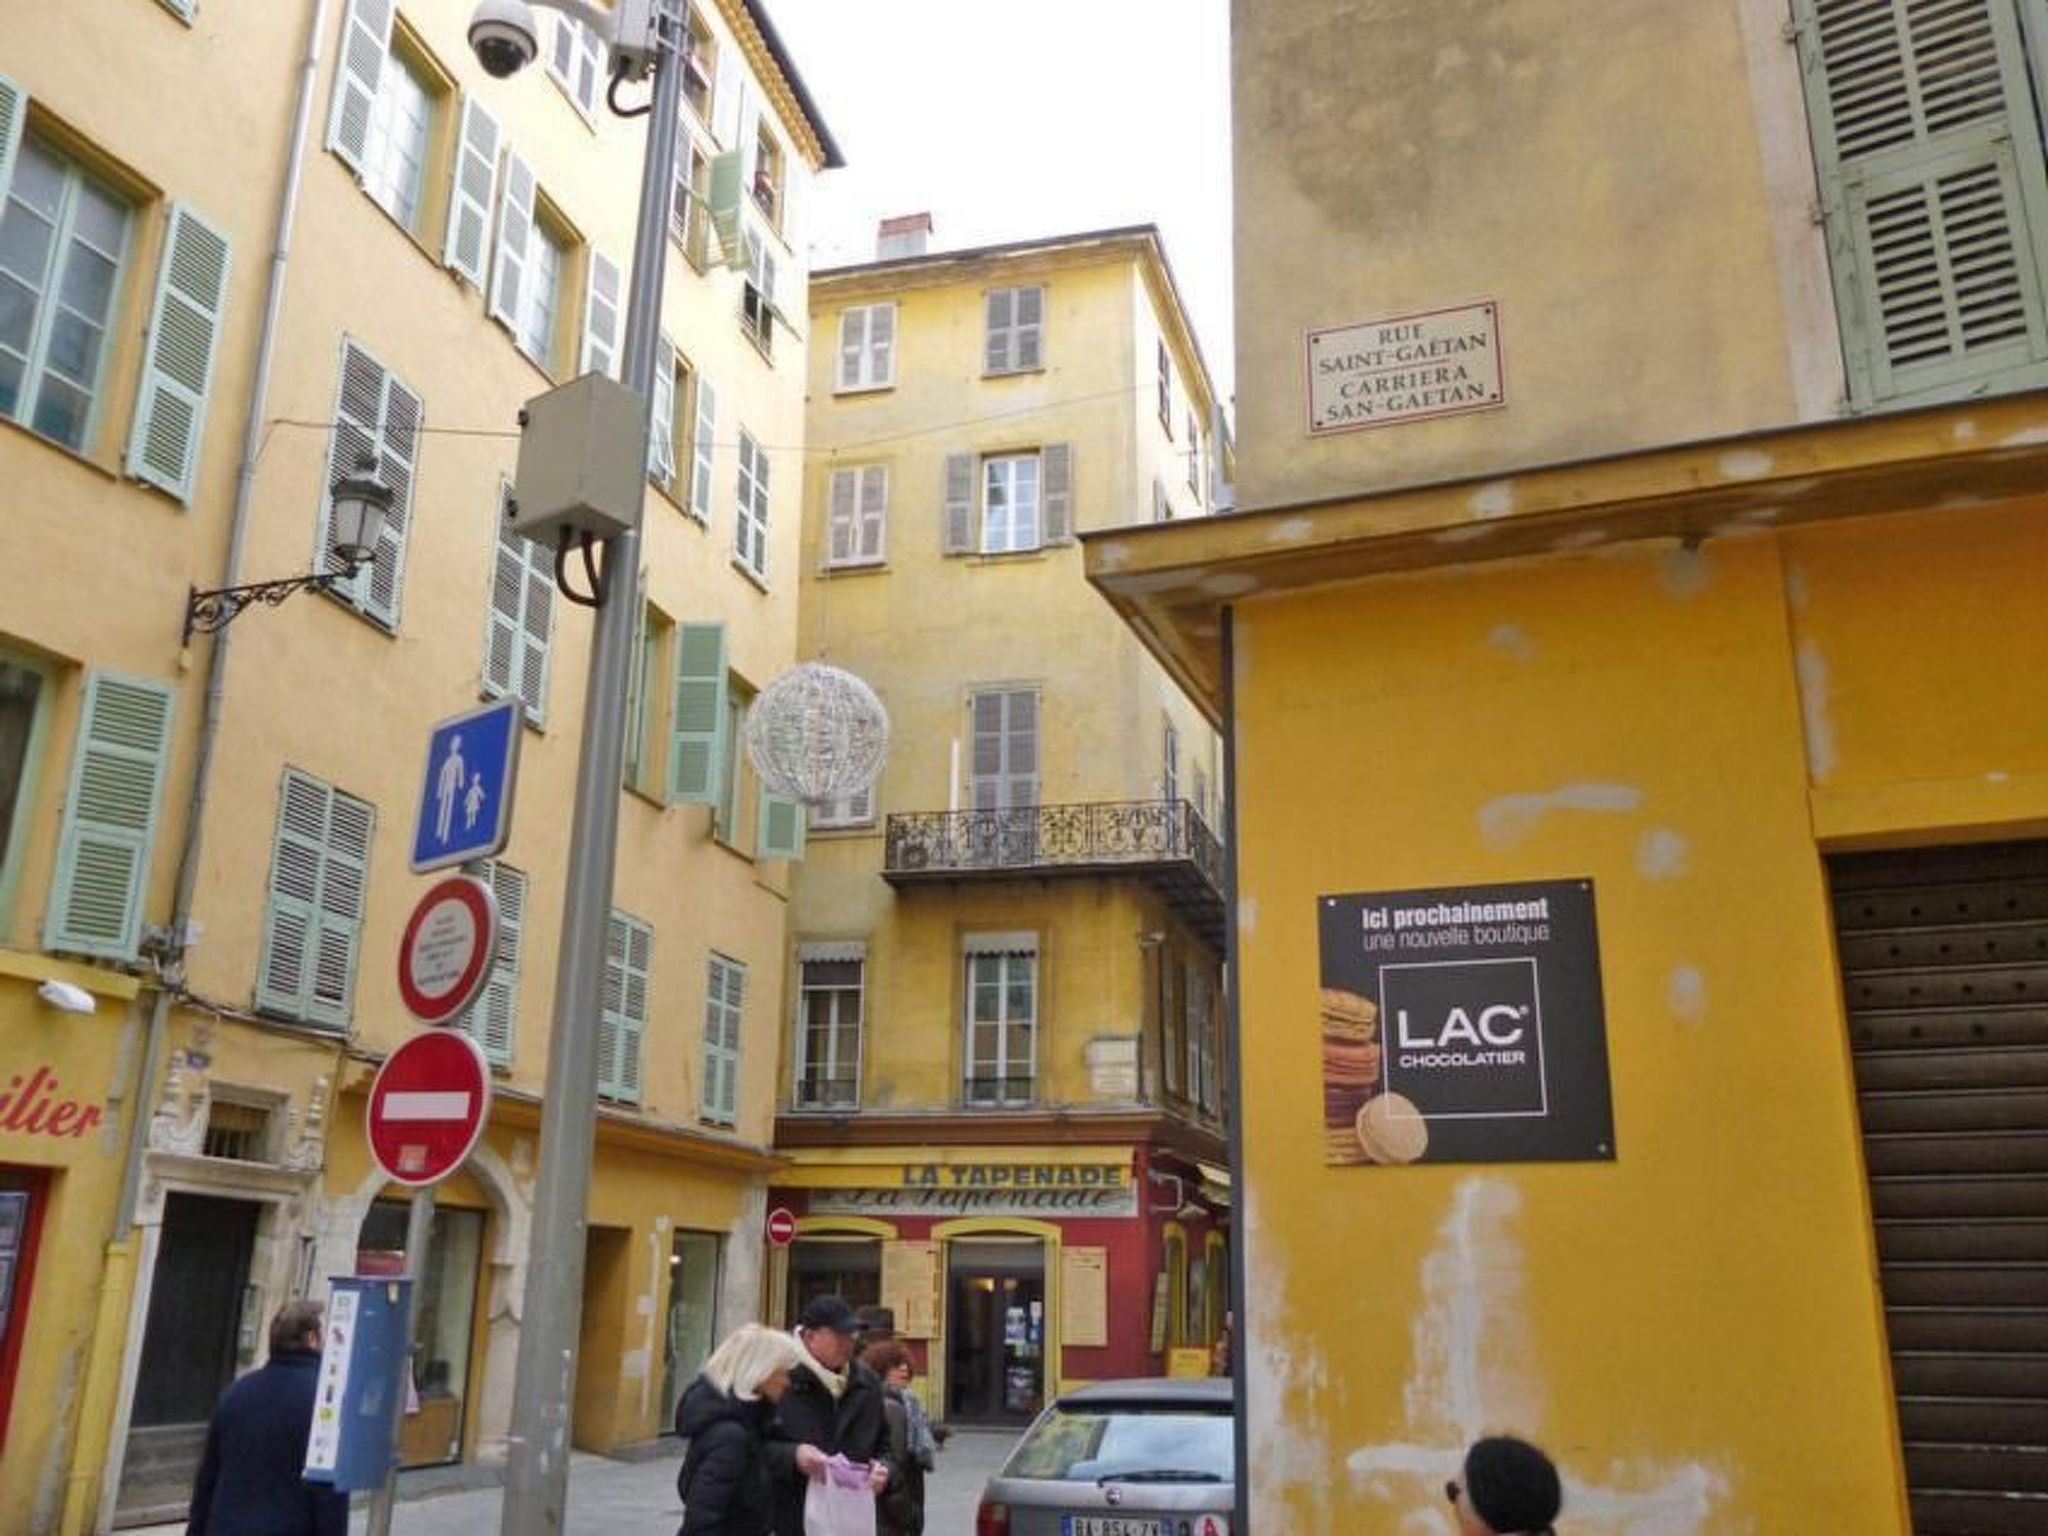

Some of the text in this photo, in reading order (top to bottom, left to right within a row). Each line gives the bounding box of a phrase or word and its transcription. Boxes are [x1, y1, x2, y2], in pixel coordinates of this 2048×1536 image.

[1378, 323, 1424, 345] RUE
[1340, 365, 1468, 399] CARRIERA
[1393, 898, 1549, 931] prochainement
[1363, 923, 1550, 952] une nouvelle boutique
[1399, 1052, 1525, 1069] CHOCOLATIER
[903, 1163, 1121, 1186] LA TAPENADE
